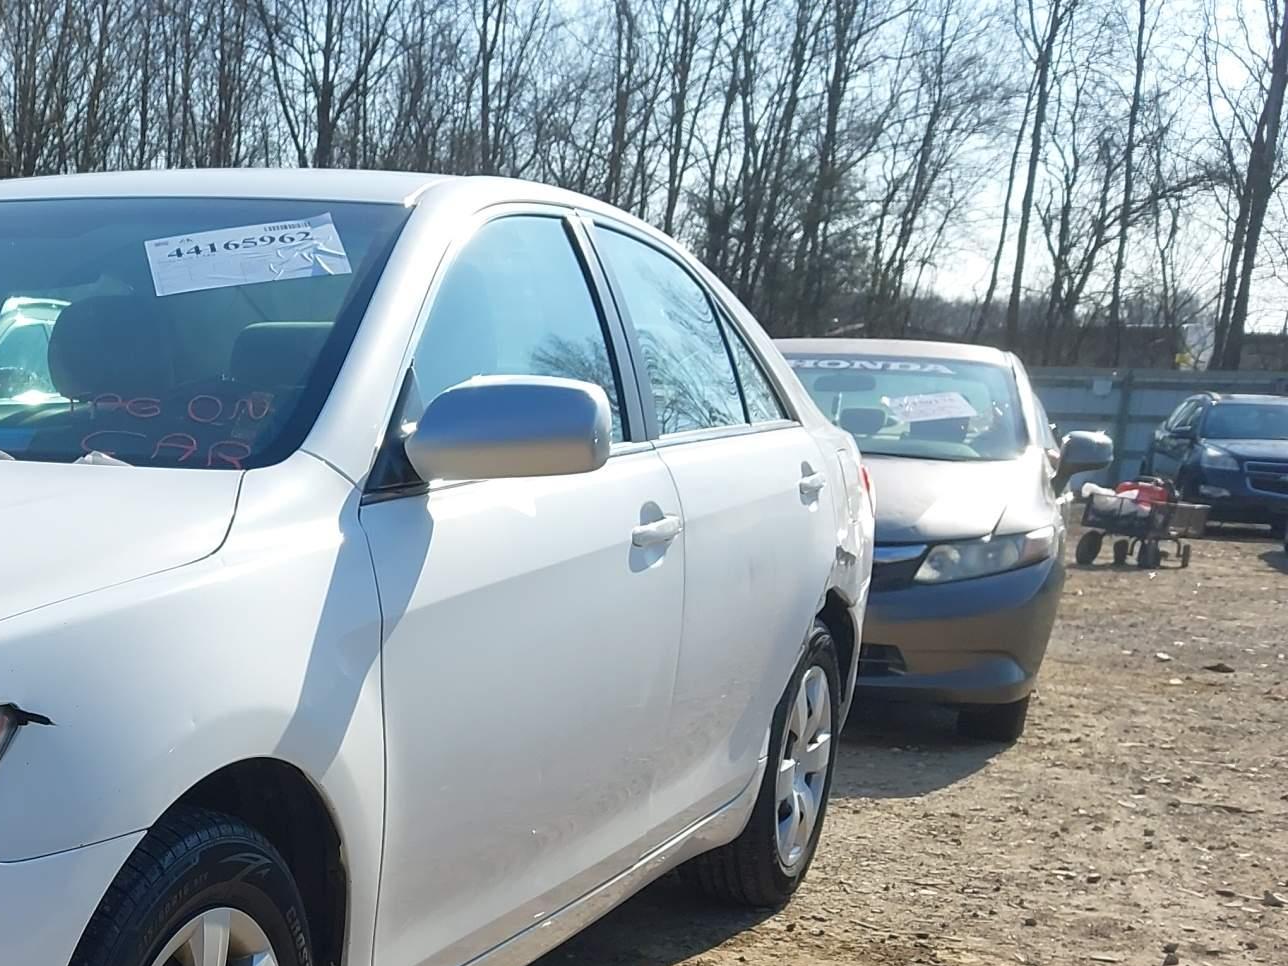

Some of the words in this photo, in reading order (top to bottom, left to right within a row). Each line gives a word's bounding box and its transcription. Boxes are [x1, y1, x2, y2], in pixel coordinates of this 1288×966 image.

[167, 231, 316, 258] 44165962
[787, 358, 958, 375] HONDA
[80, 430, 252, 470] CAR
